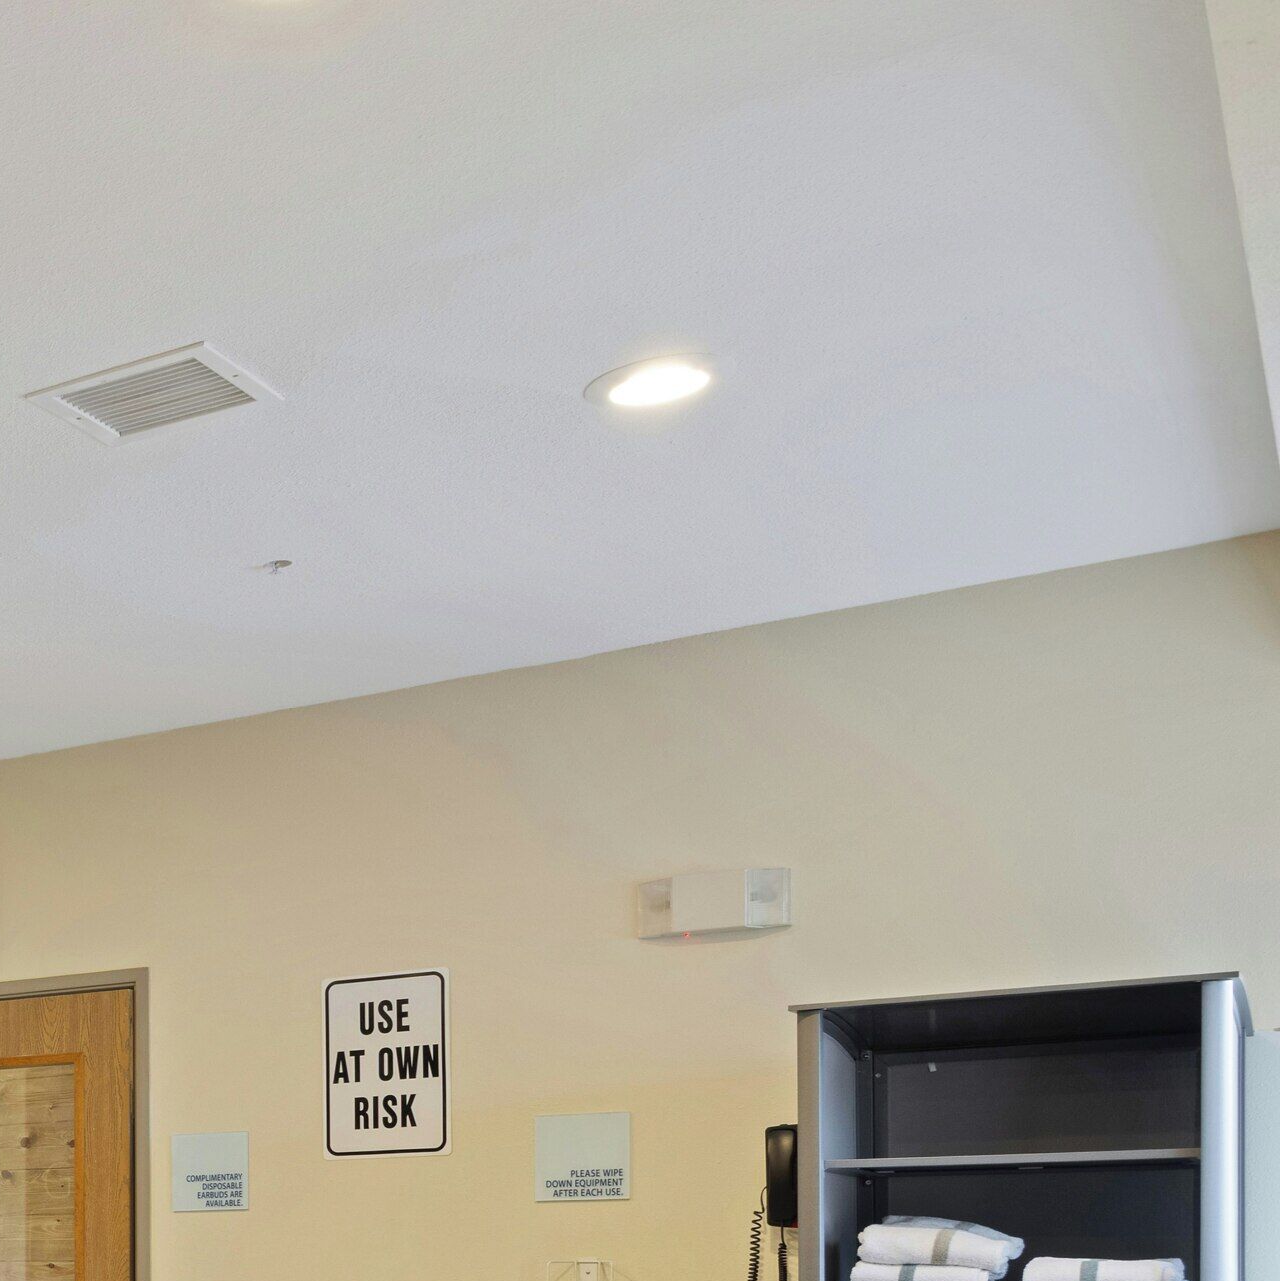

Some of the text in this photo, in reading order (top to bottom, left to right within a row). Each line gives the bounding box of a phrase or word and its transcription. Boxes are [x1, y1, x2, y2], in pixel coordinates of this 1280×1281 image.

[360, 998, 410, 1035] USE
[333, 1044, 439, 1084] AT OWN
[354, 1094, 417, 1130] RISK
[570, 1168, 623, 1177] PLEASE WIPE
[186, 1173, 243, 1182] COMPLIMENTARY
[202, 1182, 243, 1190] DISPOSABLE
[546, 1178, 623, 1188] DOWN EQUIPMENT
[198, 1191, 228, 1199] EARBUDS
[553, 1188, 623, 1197] AFTER EACH USE.
[206, 1199, 243, 1207] AVAILABLE.
